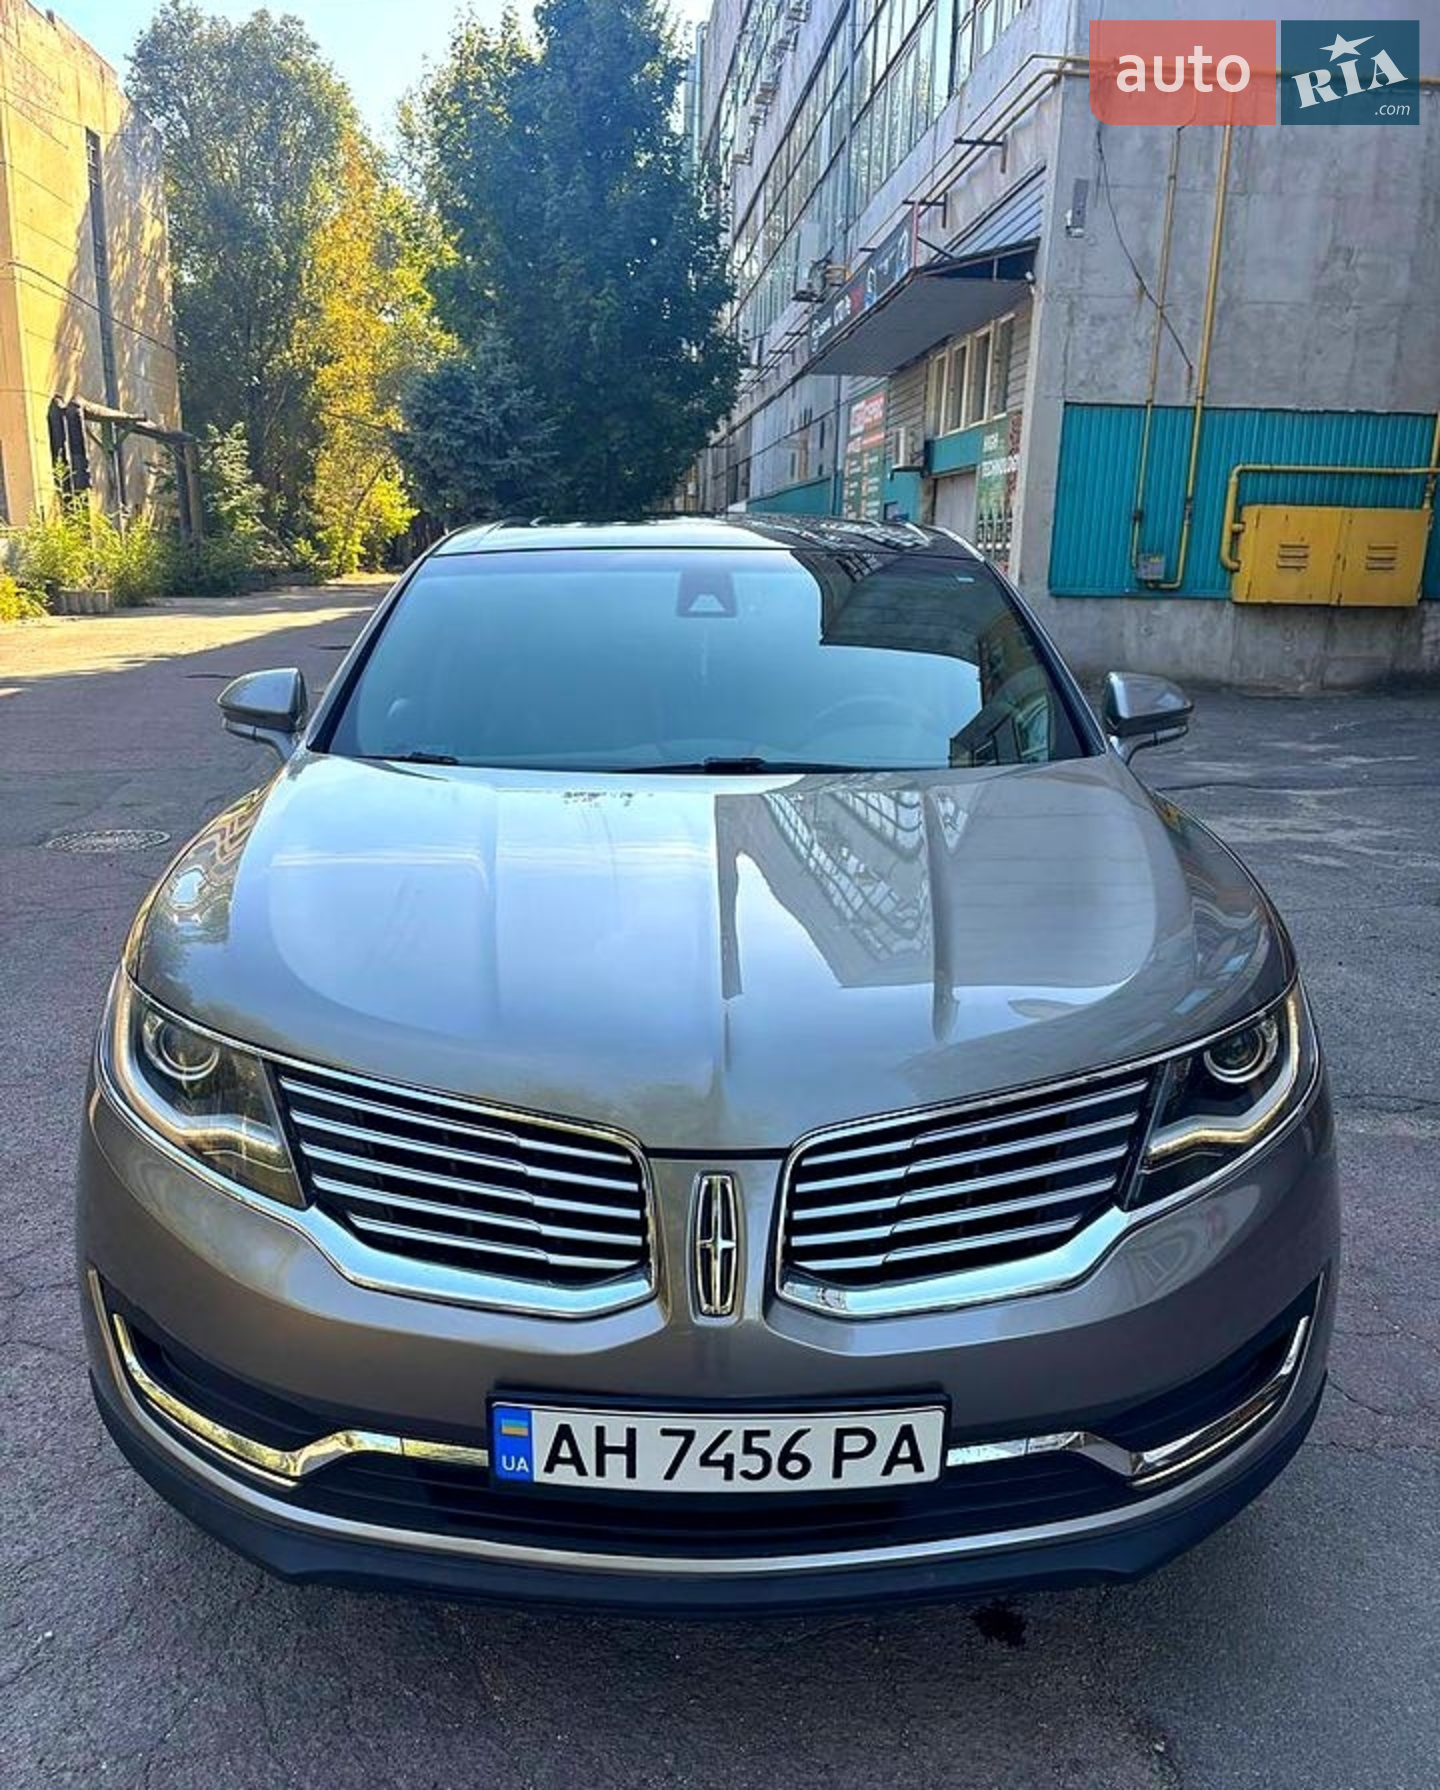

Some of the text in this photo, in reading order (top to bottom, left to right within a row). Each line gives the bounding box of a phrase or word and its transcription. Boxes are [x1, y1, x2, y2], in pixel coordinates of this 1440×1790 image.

[501, 1456, 530, 1473] UA
[542, 1423, 925, 1481] AH 7456 PA
